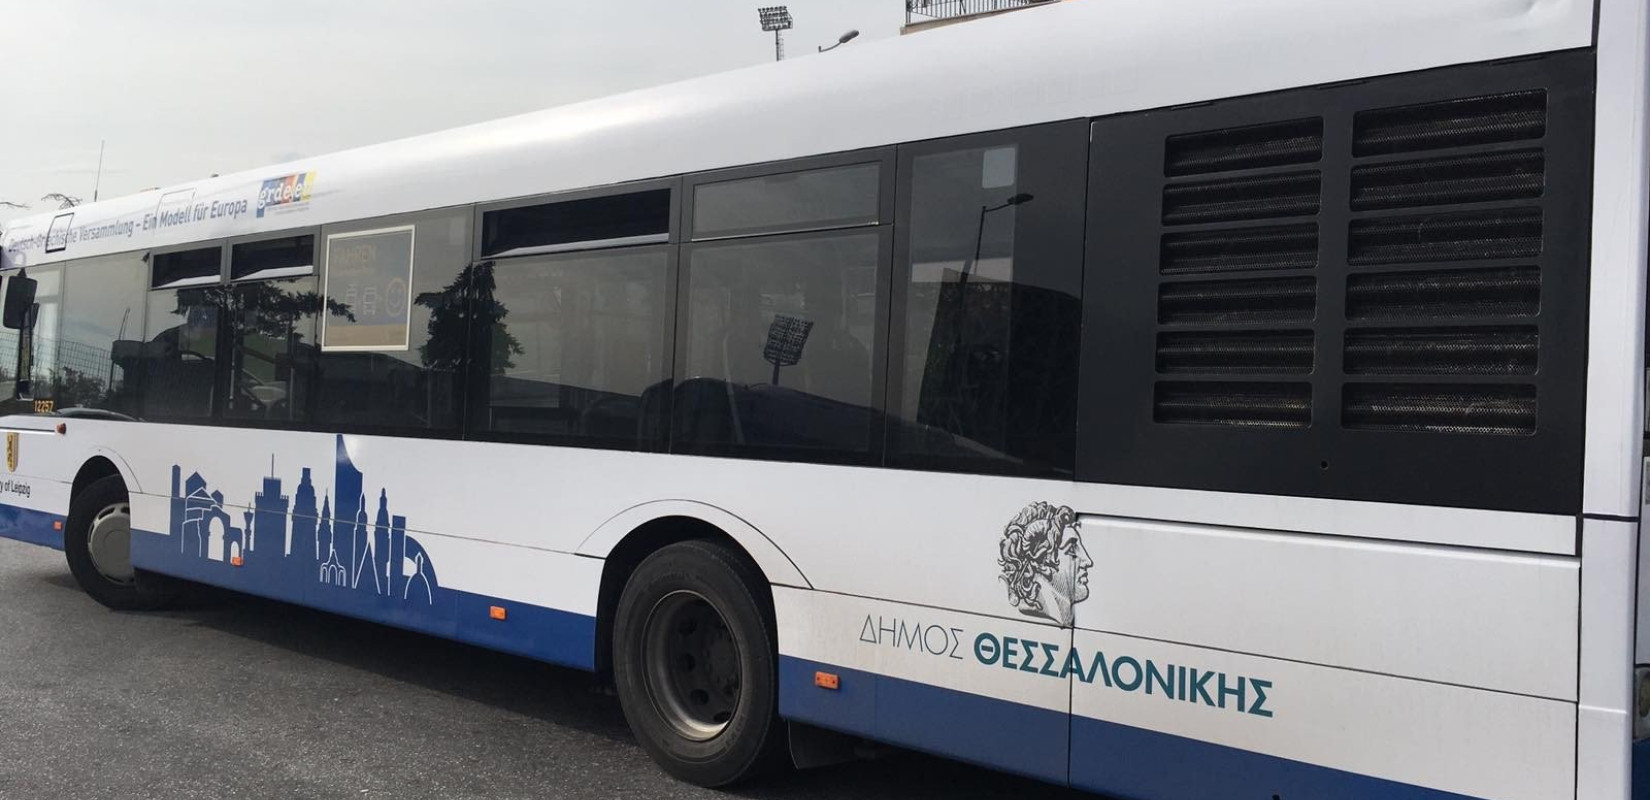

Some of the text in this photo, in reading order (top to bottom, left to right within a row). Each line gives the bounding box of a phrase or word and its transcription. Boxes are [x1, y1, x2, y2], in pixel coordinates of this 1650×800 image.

[79, 220, 134, 242] Versammlung
[143, 213, 157, 230] Ein
[160, 206, 191, 227] Modell
[192, 202, 208, 221] für
[210, 200, 248, 219] Europa
[34, 400, 54, 412] 12257
[5, 480, 10, 491] of
[11, 480, 31, 498] Leipzig
[859, 614, 1274, 718] ΔΗΜΟΣ ΘΕΣΣΑΛΟΝΙΚΗΣ
